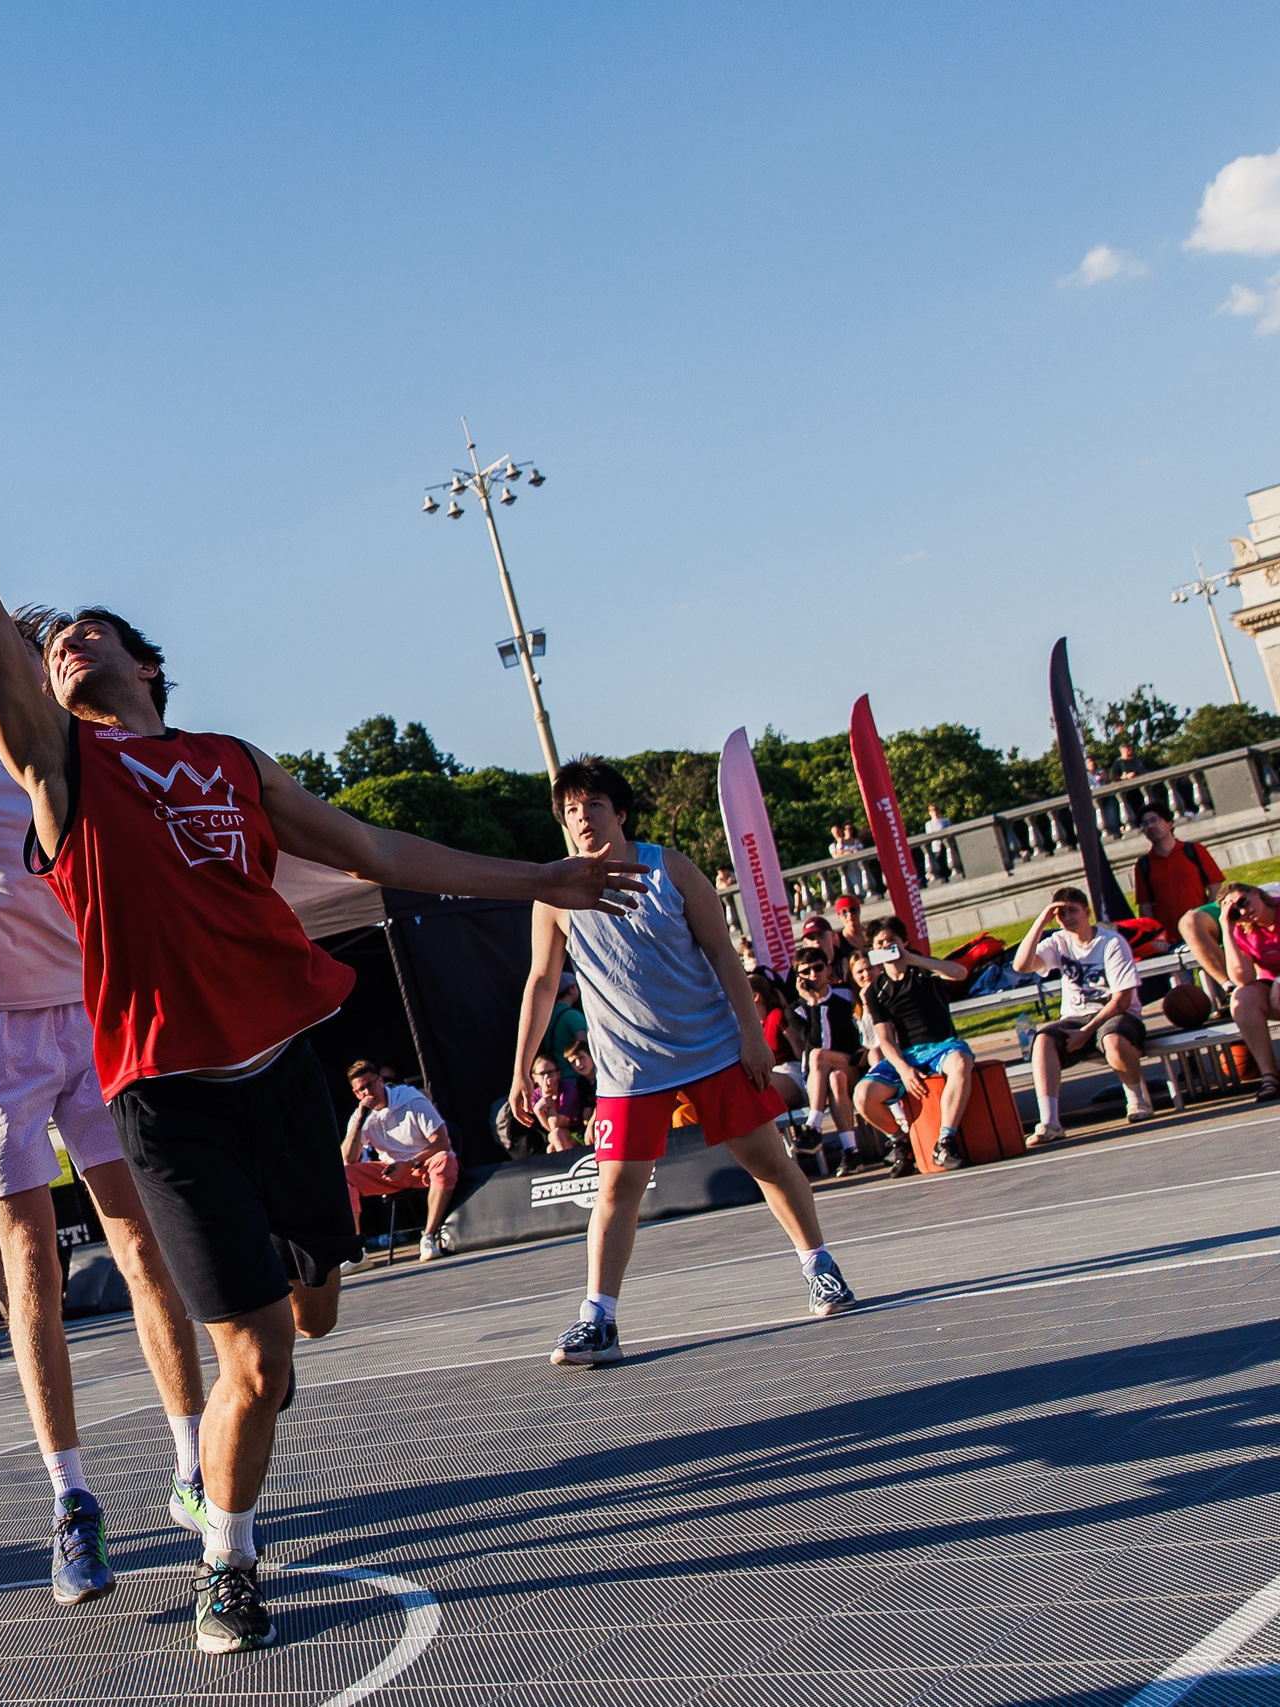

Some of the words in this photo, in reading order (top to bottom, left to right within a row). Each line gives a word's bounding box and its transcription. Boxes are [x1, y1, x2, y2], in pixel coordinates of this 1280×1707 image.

[210, 814, 245, 828] CUP
[741, 832, 790, 973] МОСКОВСКИЙ
[772, 903, 797, 964] ПОРТ
[531, 1176, 599, 1200] STREETB
